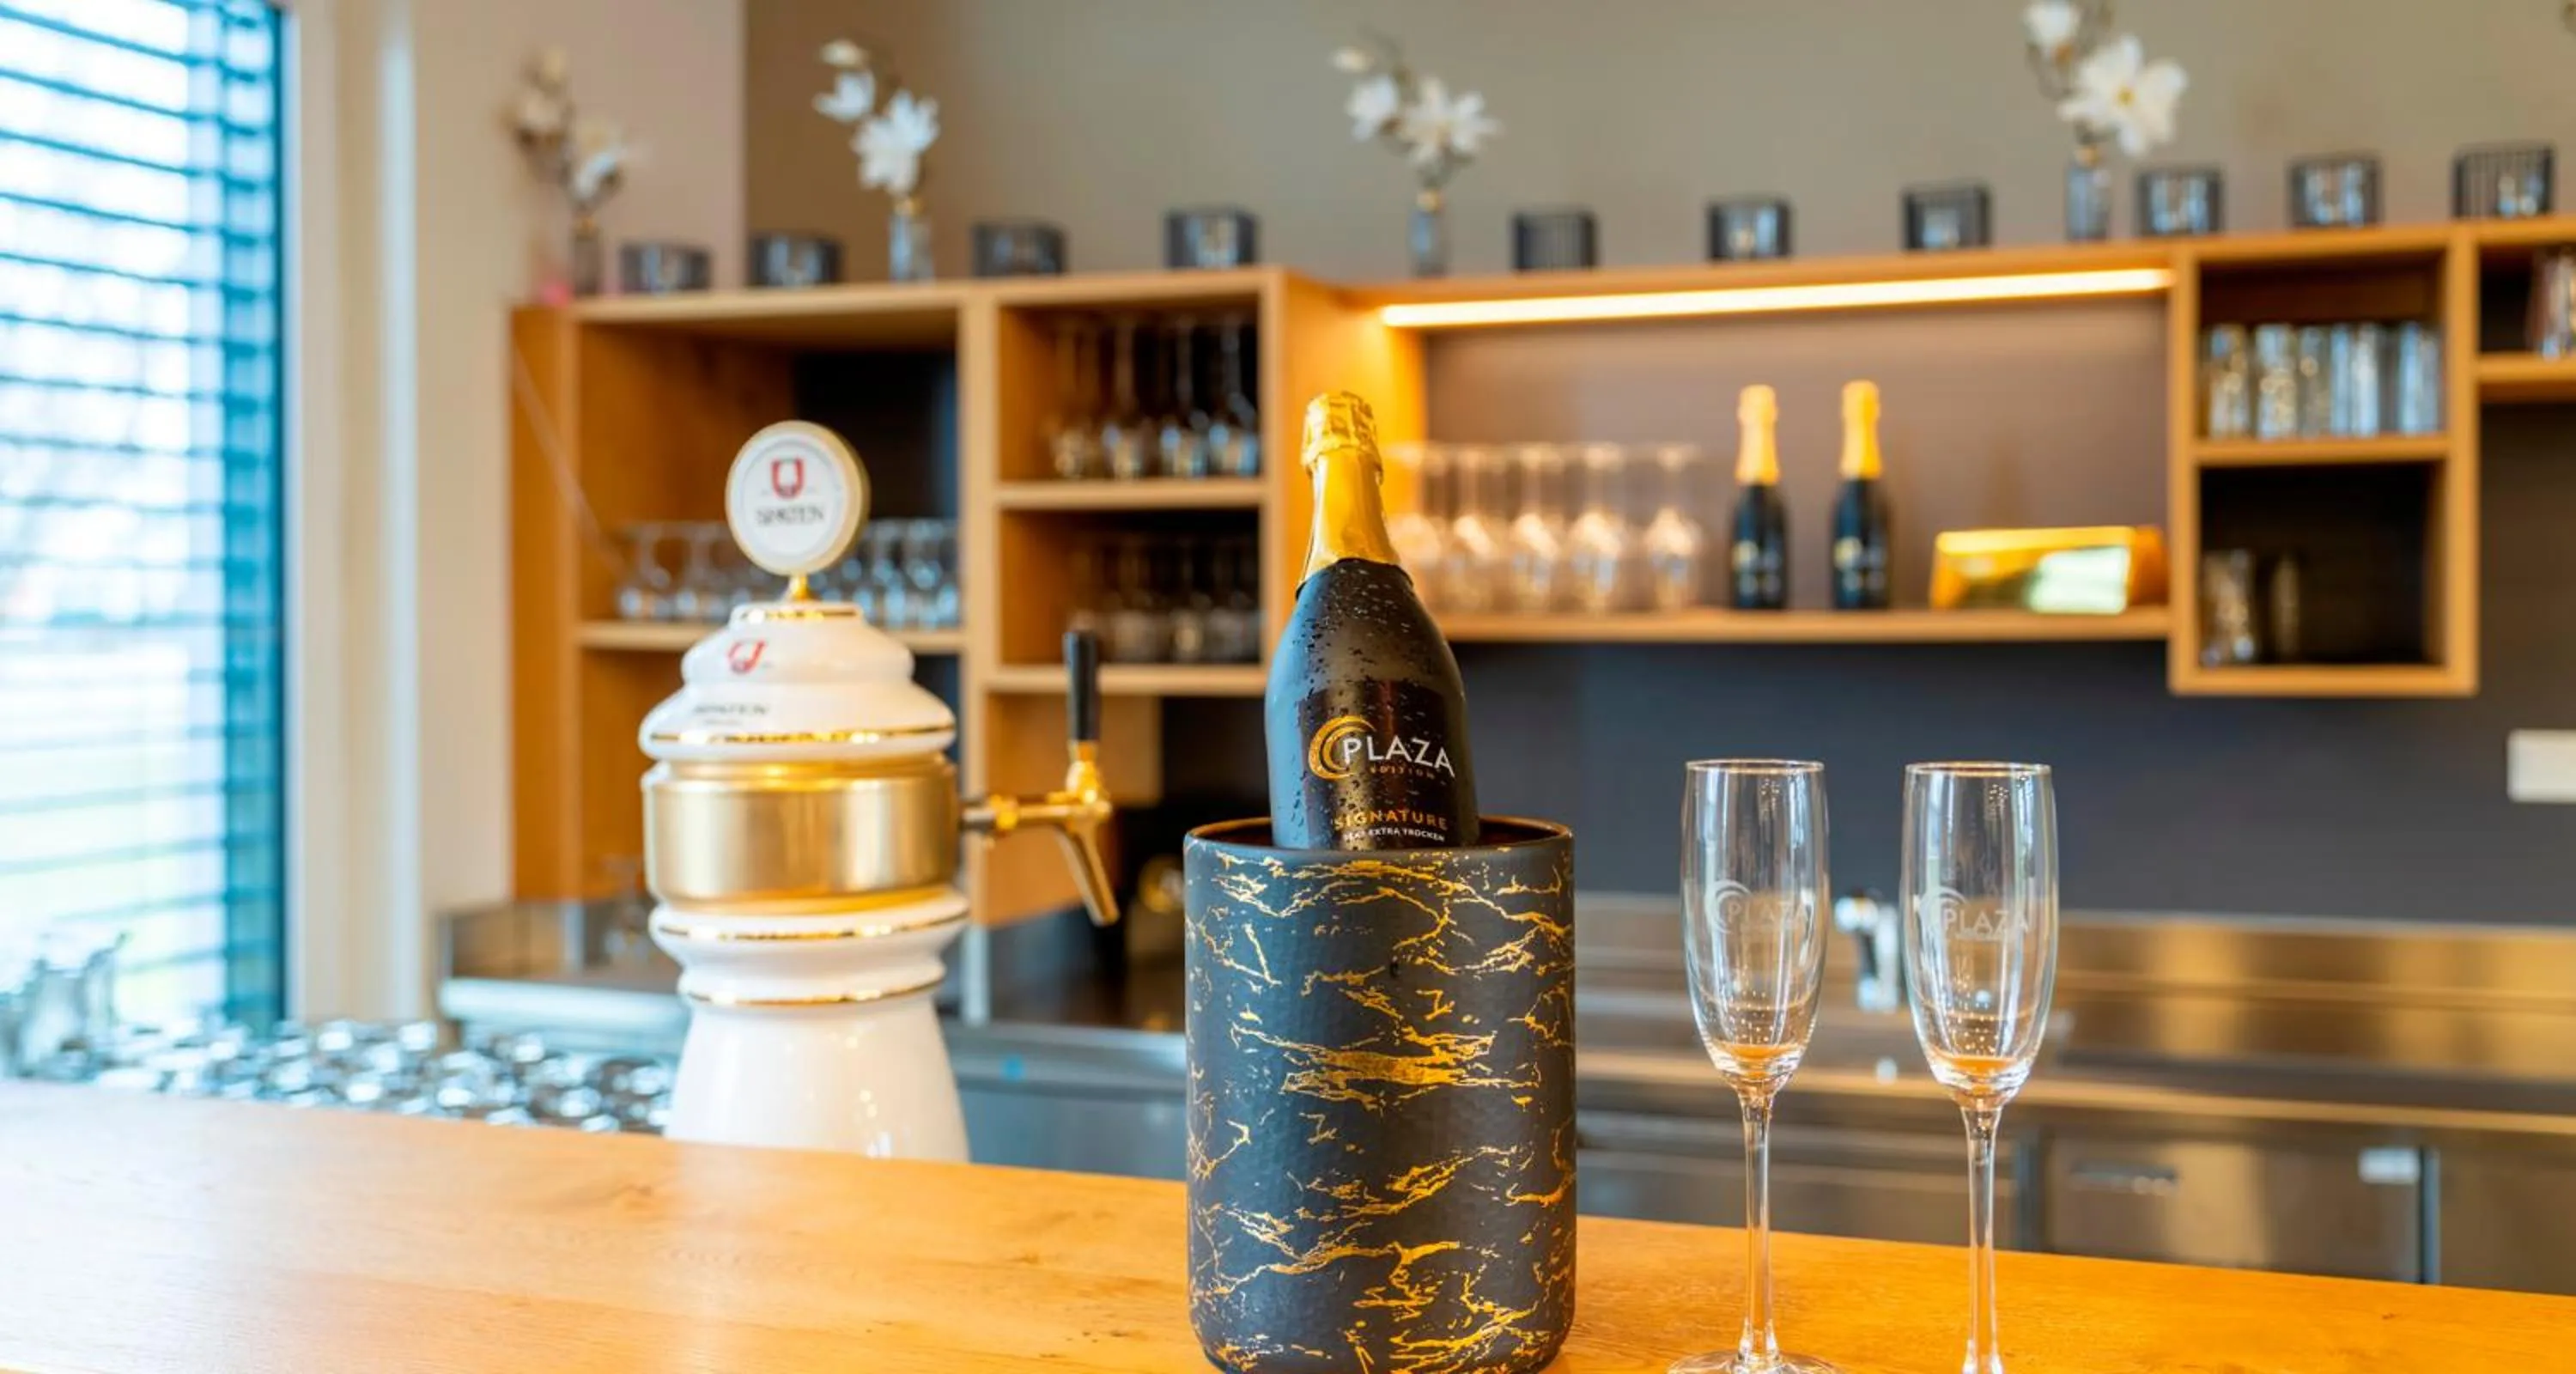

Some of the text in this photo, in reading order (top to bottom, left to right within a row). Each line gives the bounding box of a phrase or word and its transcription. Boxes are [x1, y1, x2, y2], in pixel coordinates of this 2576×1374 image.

[1342, 735, 1455, 778] PLAZA
[1334, 810, 1448, 830] SIGNATURE
[1368, 827, 1400, 837] EXTRA
[1402, 828, 1444, 842] TROCKEN
[1943, 908, 2029, 935] PLAZA
